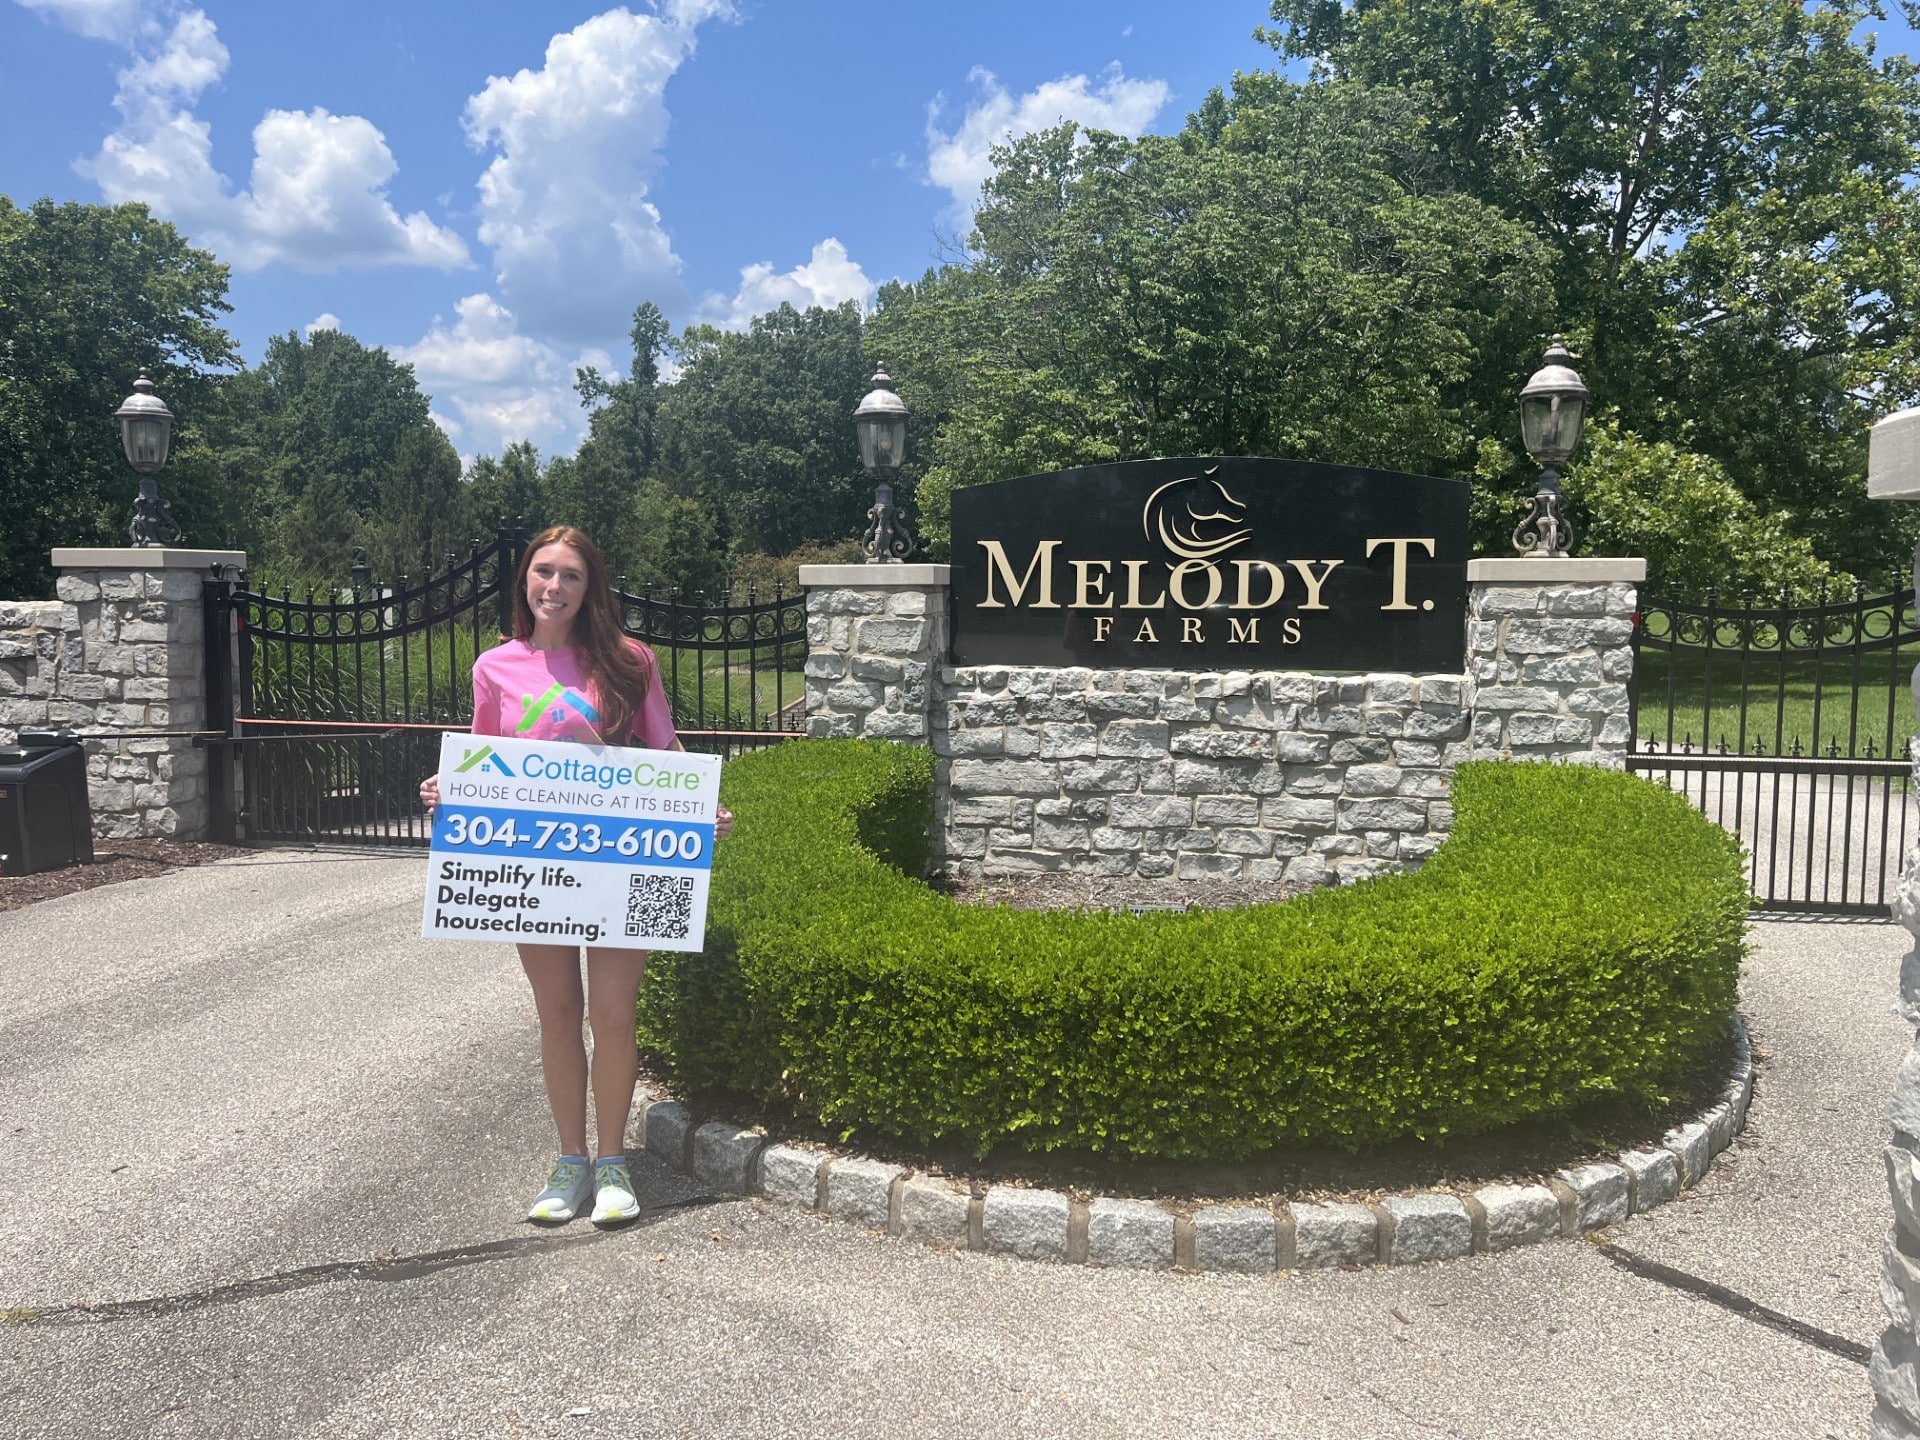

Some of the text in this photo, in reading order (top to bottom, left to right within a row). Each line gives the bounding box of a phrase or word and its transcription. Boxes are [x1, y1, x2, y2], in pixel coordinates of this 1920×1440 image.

[976, 538, 1436, 611] MELODY T.
[1092, 616, 1303, 645] FARMS
[450, 783, 705, 815] HOUSE CLEANING AT ITS BEST!
[444, 813, 702, 861] 304-733-6100
[439, 861, 582, 888] Simplify life.
[437, 885, 540, 912] Delegate
[434, 909, 607, 942] housecleaning.
